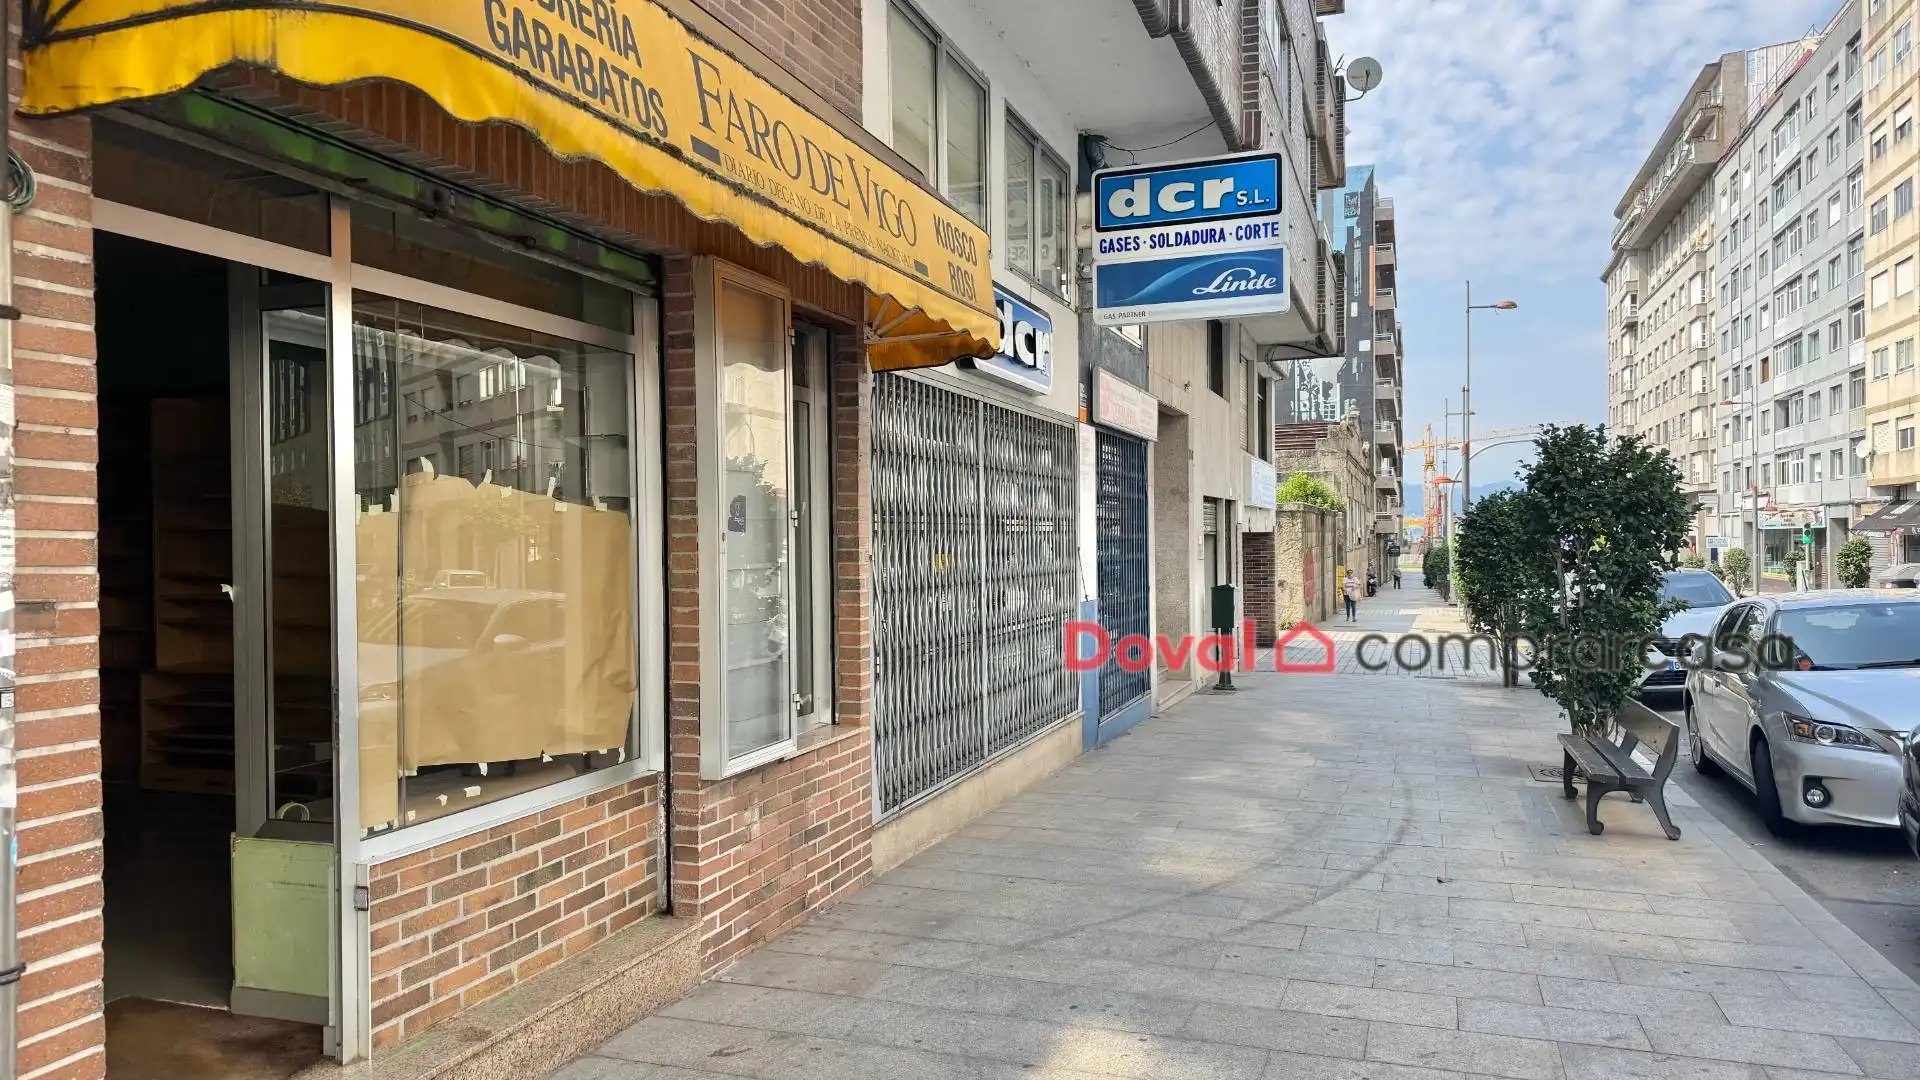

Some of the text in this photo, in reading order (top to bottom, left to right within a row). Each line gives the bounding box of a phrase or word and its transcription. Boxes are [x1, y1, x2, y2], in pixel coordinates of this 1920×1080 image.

[484, 0, 669, 138] GARABATOS
[686, 48, 917, 247] FARO DE VIGO
[723, 153, 765, 190] DIARIO
[768, 177, 811, 215] DECANO
[814, 203, 828, 224] DE
[1108, 176, 1270, 218] dcr S.L.
[933, 213, 978, 267] KIOSCO
[1099, 221, 1280, 254] GASES SOLDADURA CORTE
[948, 261, 977, 303] ROSI
[1192, 267, 1277, 295] Linde
[1118, 310, 1146, 319] PARTNER
